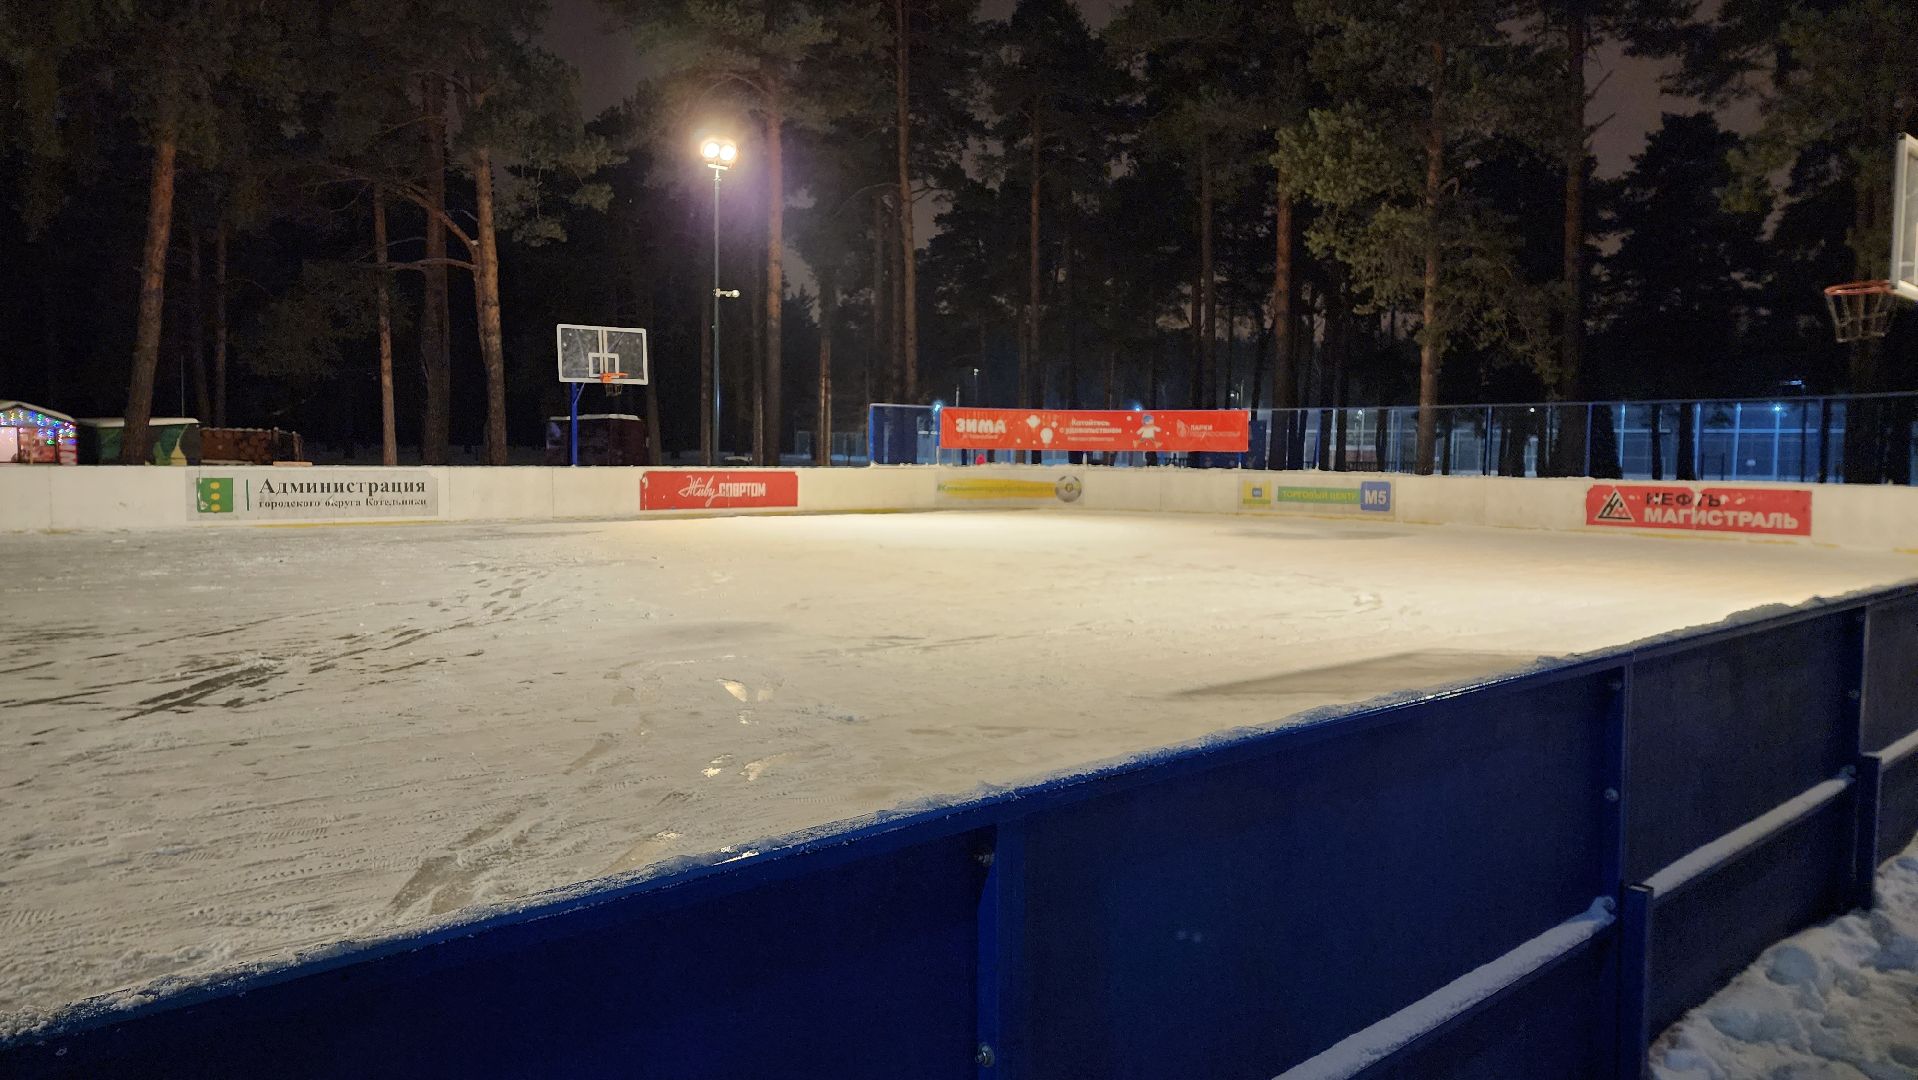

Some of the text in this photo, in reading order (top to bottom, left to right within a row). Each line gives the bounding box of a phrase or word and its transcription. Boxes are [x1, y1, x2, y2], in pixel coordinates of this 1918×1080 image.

[955, 417, 1007, 434] ЗИМА
[260, 478, 425, 497] Администрация
[259, 498, 426, 510] городского округа Котельники
[1643, 508, 1799, 529] МАГИСТРАЛЬ
